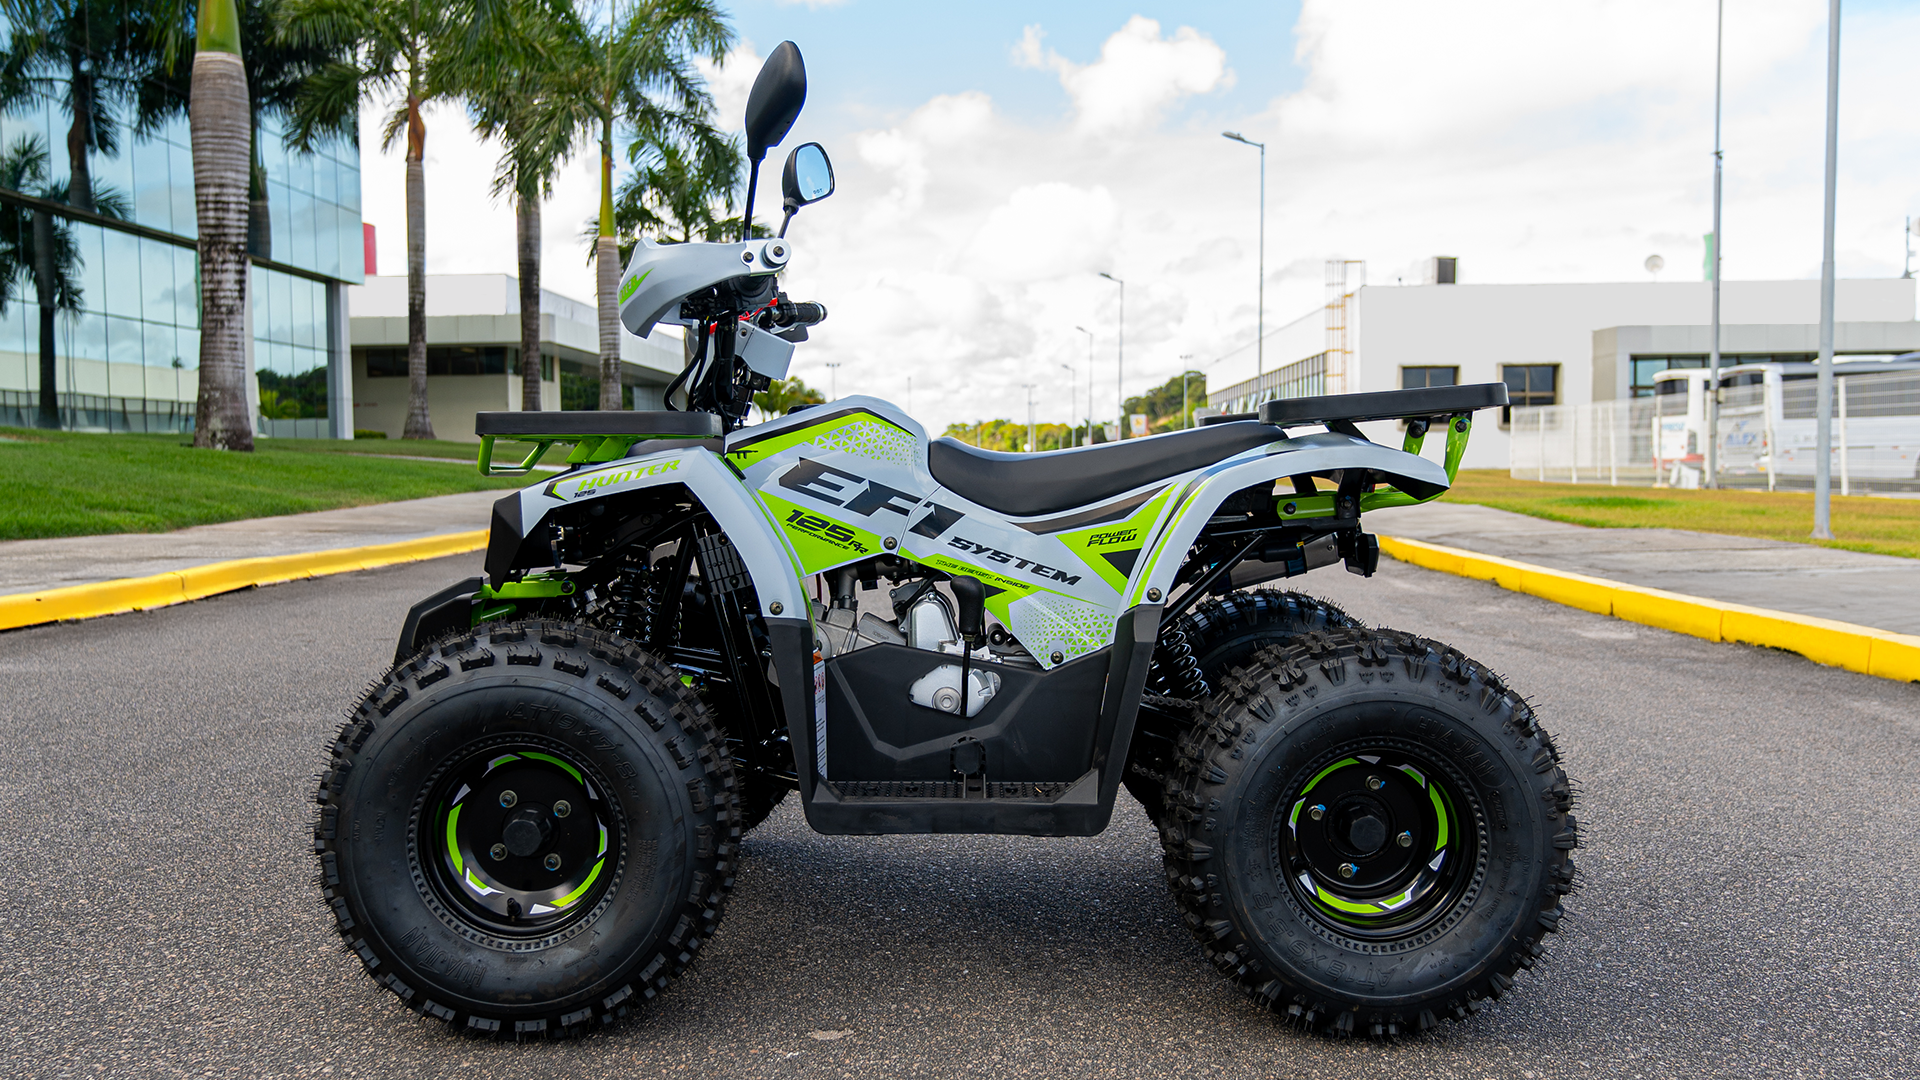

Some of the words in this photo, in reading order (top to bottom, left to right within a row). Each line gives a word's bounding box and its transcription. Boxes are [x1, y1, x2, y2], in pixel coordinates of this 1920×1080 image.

[578, 459, 681, 492] HUNTER
[573, 488, 597, 499] 125
[785, 509, 856, 543] 125
[786, 523, 850, 550] PERFORMANCE
[1089, 528, 1138, 541] POWER
[1087, 533, 1138, 548] FLOW
[947, 535, 1083, 586] SYSTEM
[994, 576, 1031, 591] INSIDE
